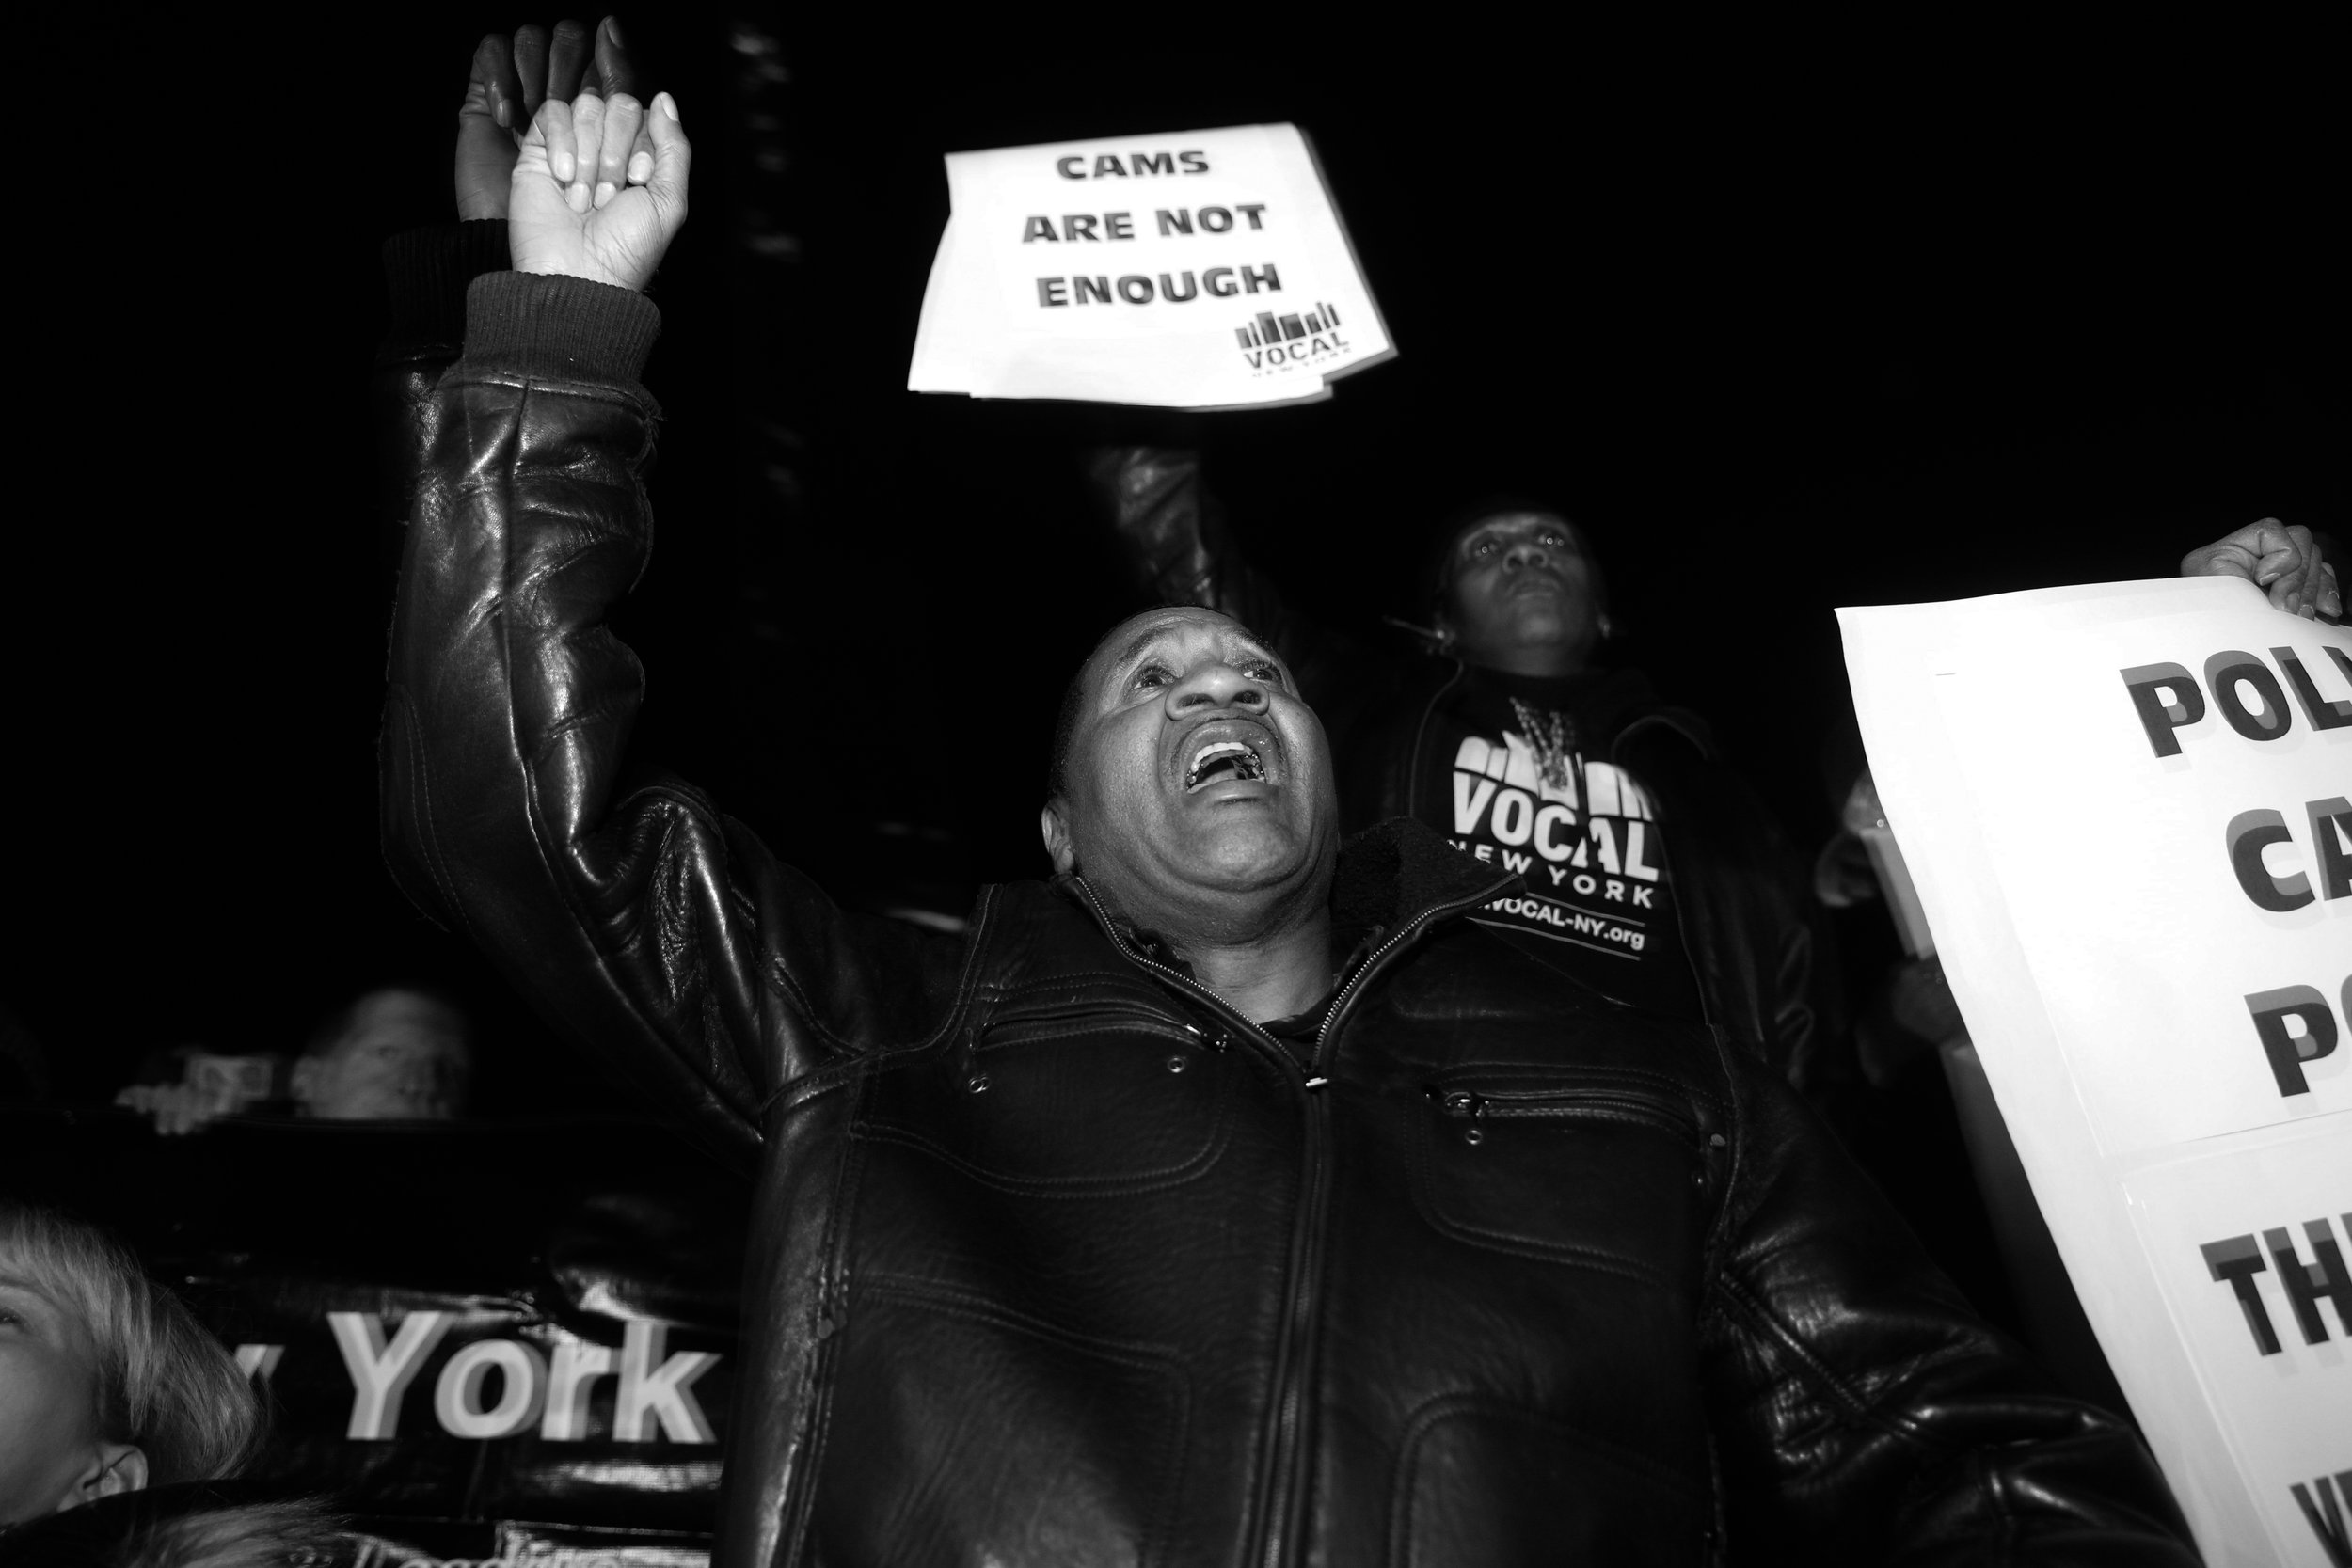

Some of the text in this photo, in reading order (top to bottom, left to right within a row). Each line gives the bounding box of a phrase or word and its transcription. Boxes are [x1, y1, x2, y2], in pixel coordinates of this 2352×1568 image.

[1057, 151, 1209, 179] CAMS
[1023, 204, 1266, 243] ARE NOT
[1036, 263, 1282, 308] ENOUGH
[1243, 332, 1350, 369] VOCAL
[1452, 770, 1660, 882] VOCAL
[1547, 864, 1655, 910] YORK
[2199, 1212, 2352, 1356] TH
[326, 1309, 724, 1446] York
